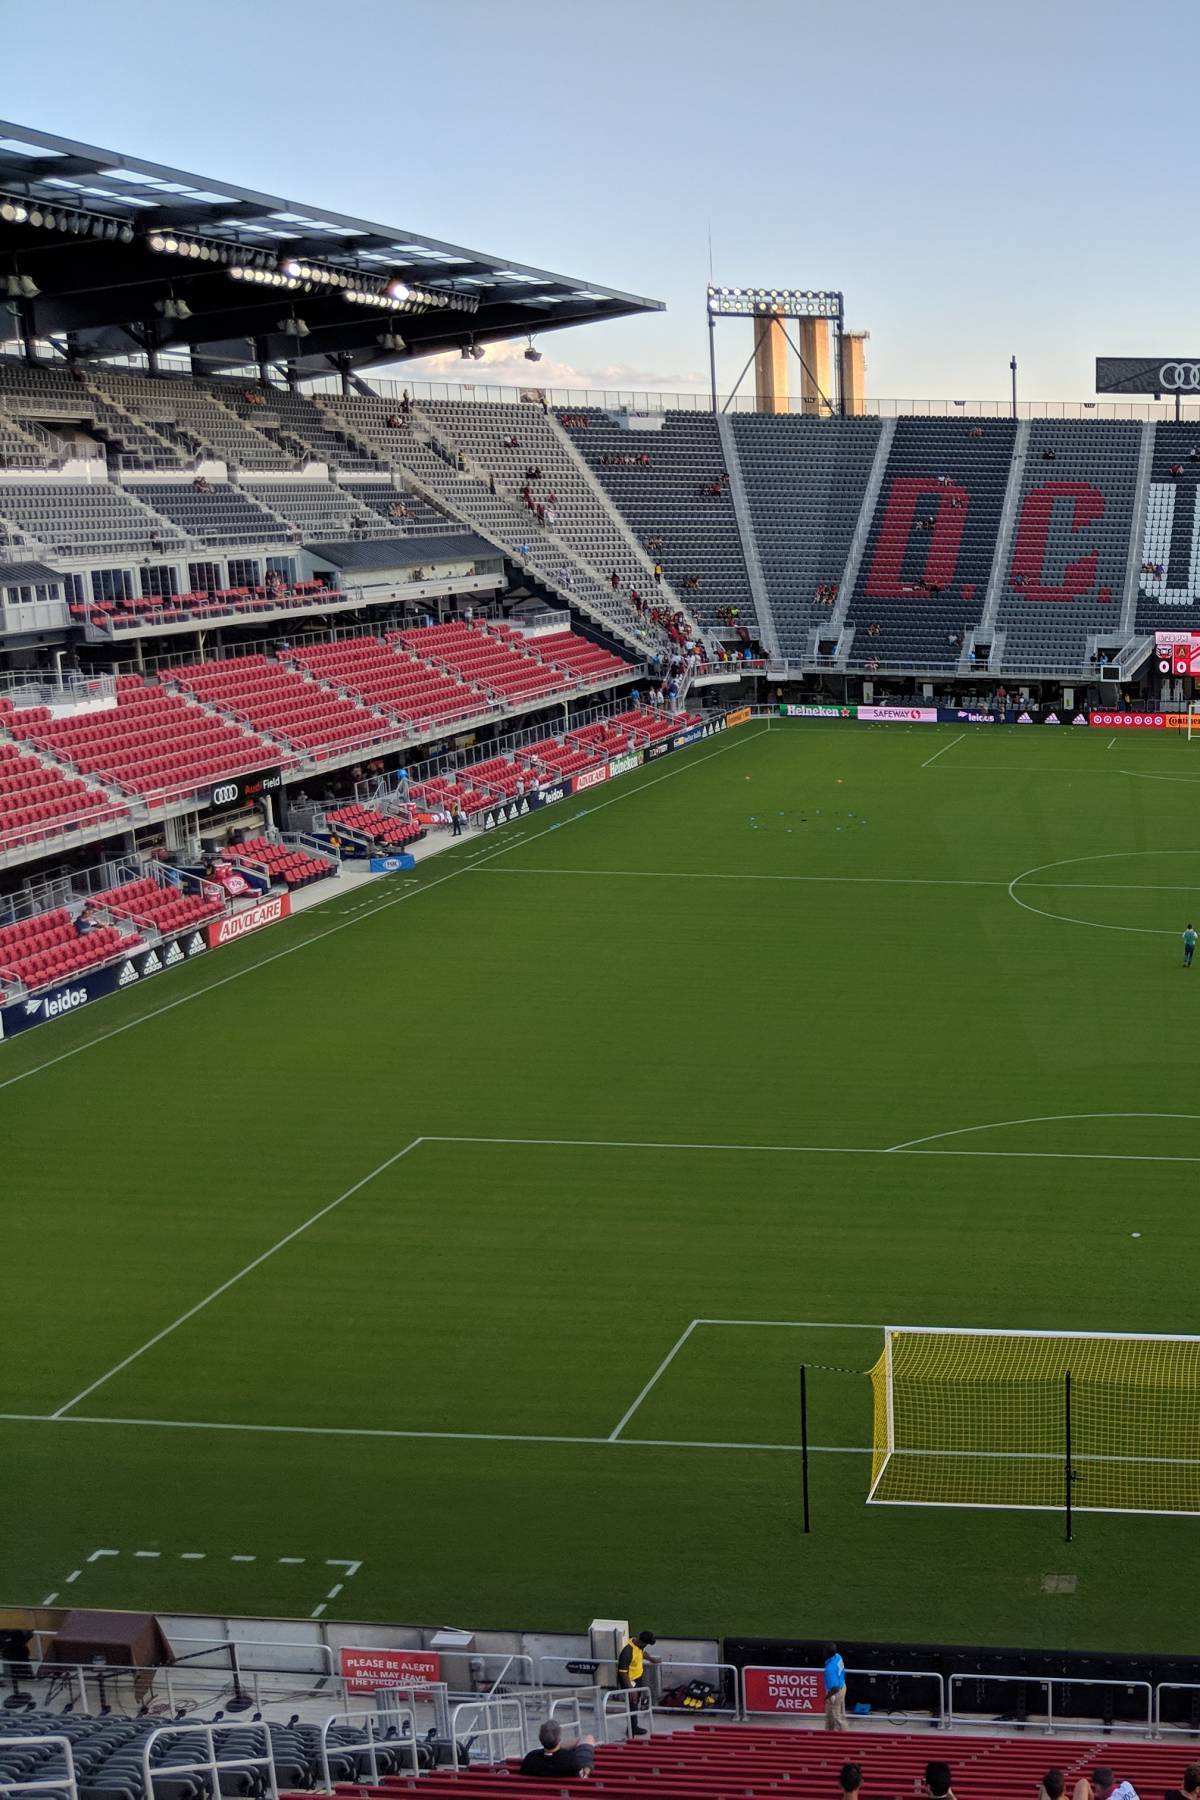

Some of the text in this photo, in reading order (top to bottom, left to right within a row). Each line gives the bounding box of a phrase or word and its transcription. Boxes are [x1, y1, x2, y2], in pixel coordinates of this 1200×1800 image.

[1159, 660, 1170, 673] 0
[1176, 661, 1187, 673] 0
[787, 705, 840, 717] Heineken
[873, 710, 909, 719] SAFEWAY
[263, 776, 280, 790] Field
[220, 899, 281, 941] ADVOCARE
[43, 987, 88, 1018] leidos
[347, 1659, 434, 1672] PLEASE BE ALERT!
[356, 1670, 426, 1681] BALL MAY LEAVE
[768, 1674, 818, 1686] SMOKE
[768, 1686, 818, 1698] DEVICE
[776, 1698, 812, 1709] AREA
